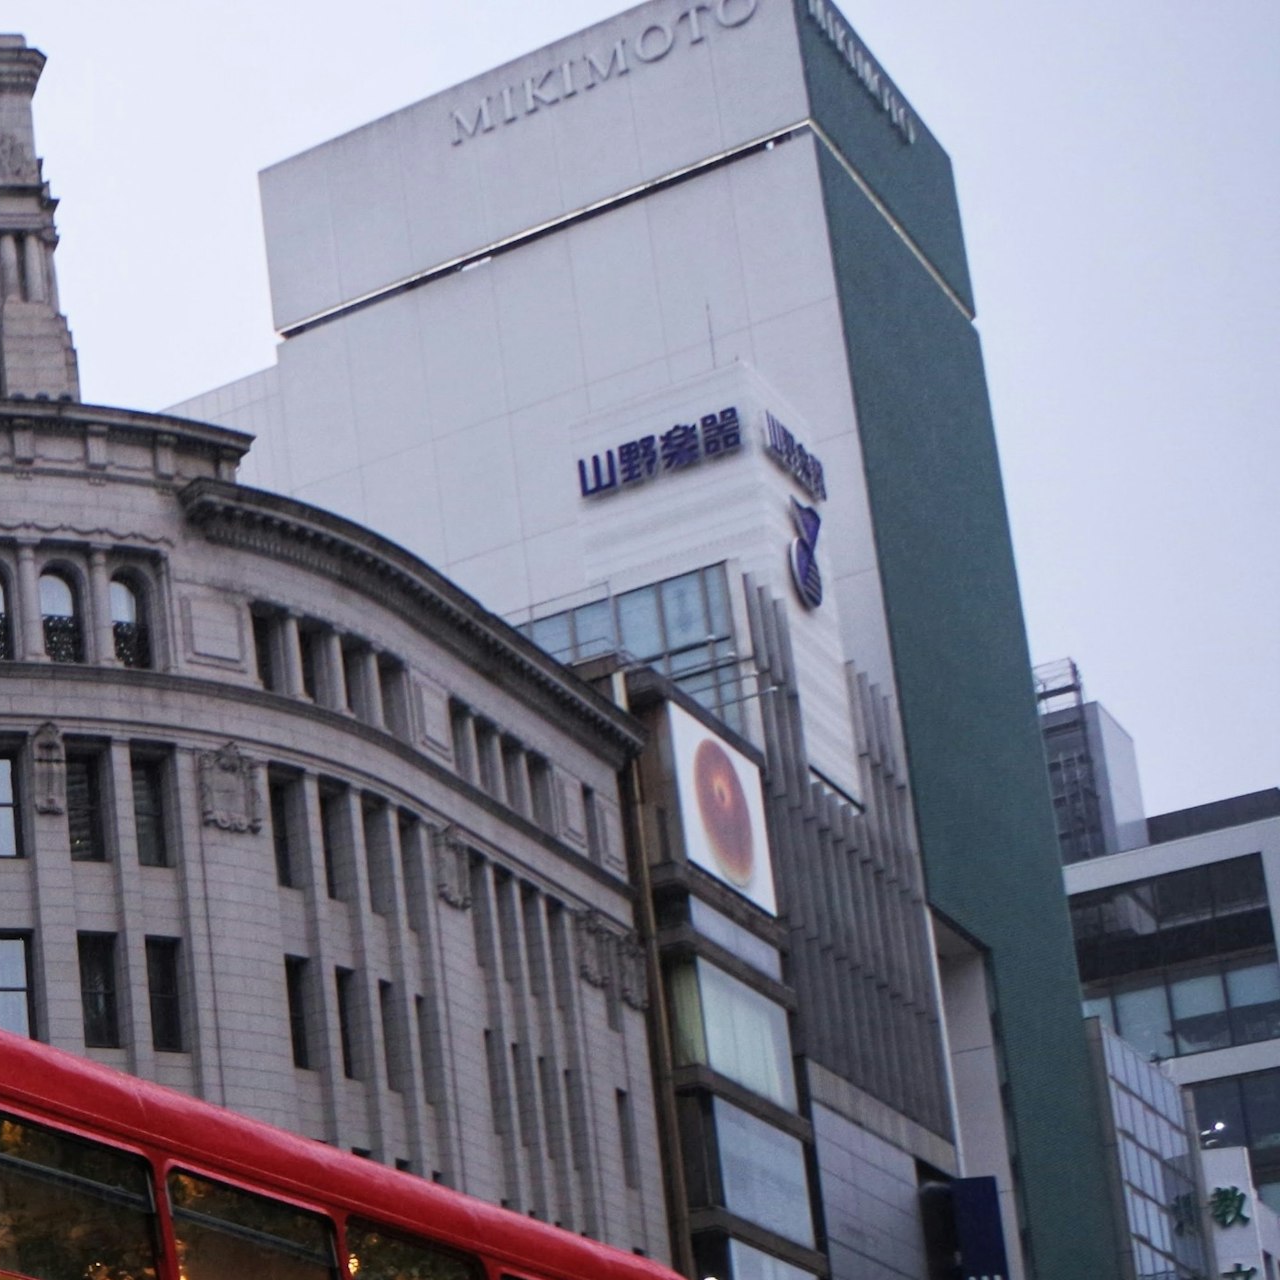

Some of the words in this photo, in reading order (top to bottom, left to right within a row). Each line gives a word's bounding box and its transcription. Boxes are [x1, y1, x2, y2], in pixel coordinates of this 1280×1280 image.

[450, 0, 757, 146] MIKIMOTO
[578, 406, 741, 497] 山野楽器
